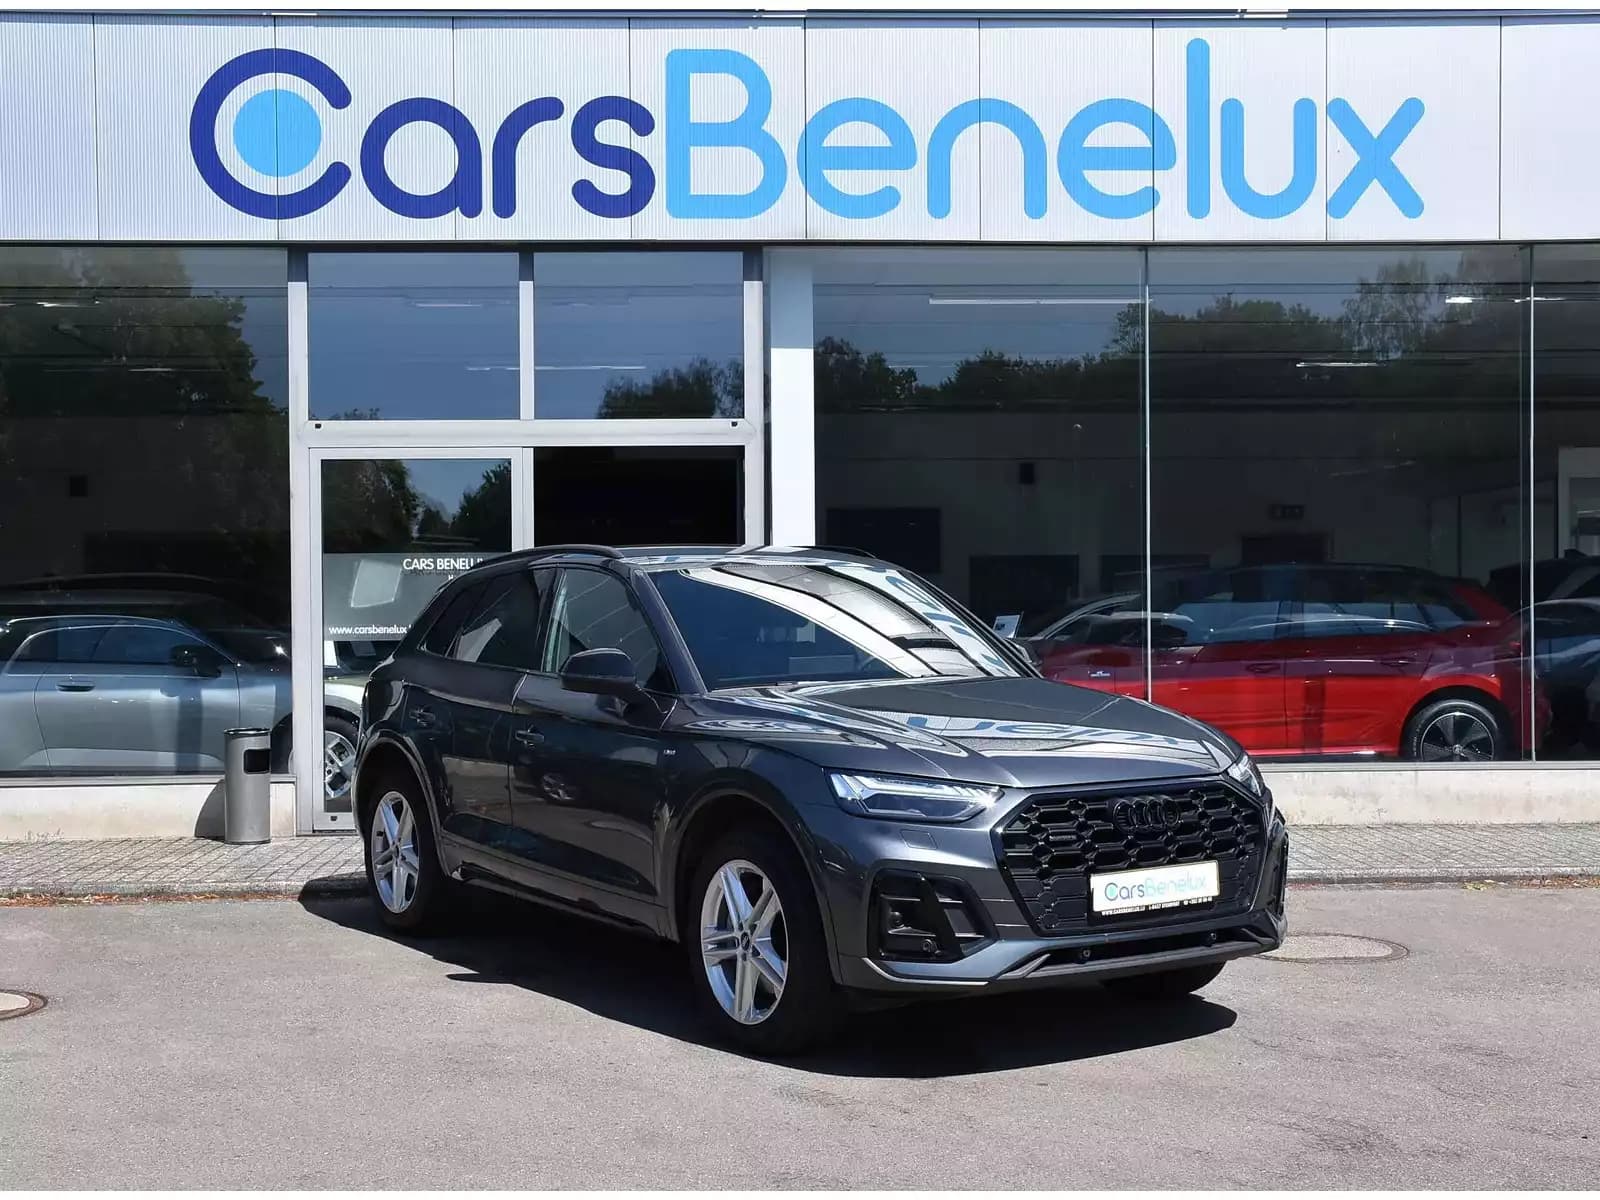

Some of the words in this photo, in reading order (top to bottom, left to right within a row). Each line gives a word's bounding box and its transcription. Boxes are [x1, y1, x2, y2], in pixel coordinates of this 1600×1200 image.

[189, 38, 1425, 219] CarsBenelux
[403, 558, 434, 570] CARS
[436, 557, 484, 570] BENEL
[328, 624, 412, 634] www.carsbenelux
[1104, 871, 1207, 901] CarsBenelux
